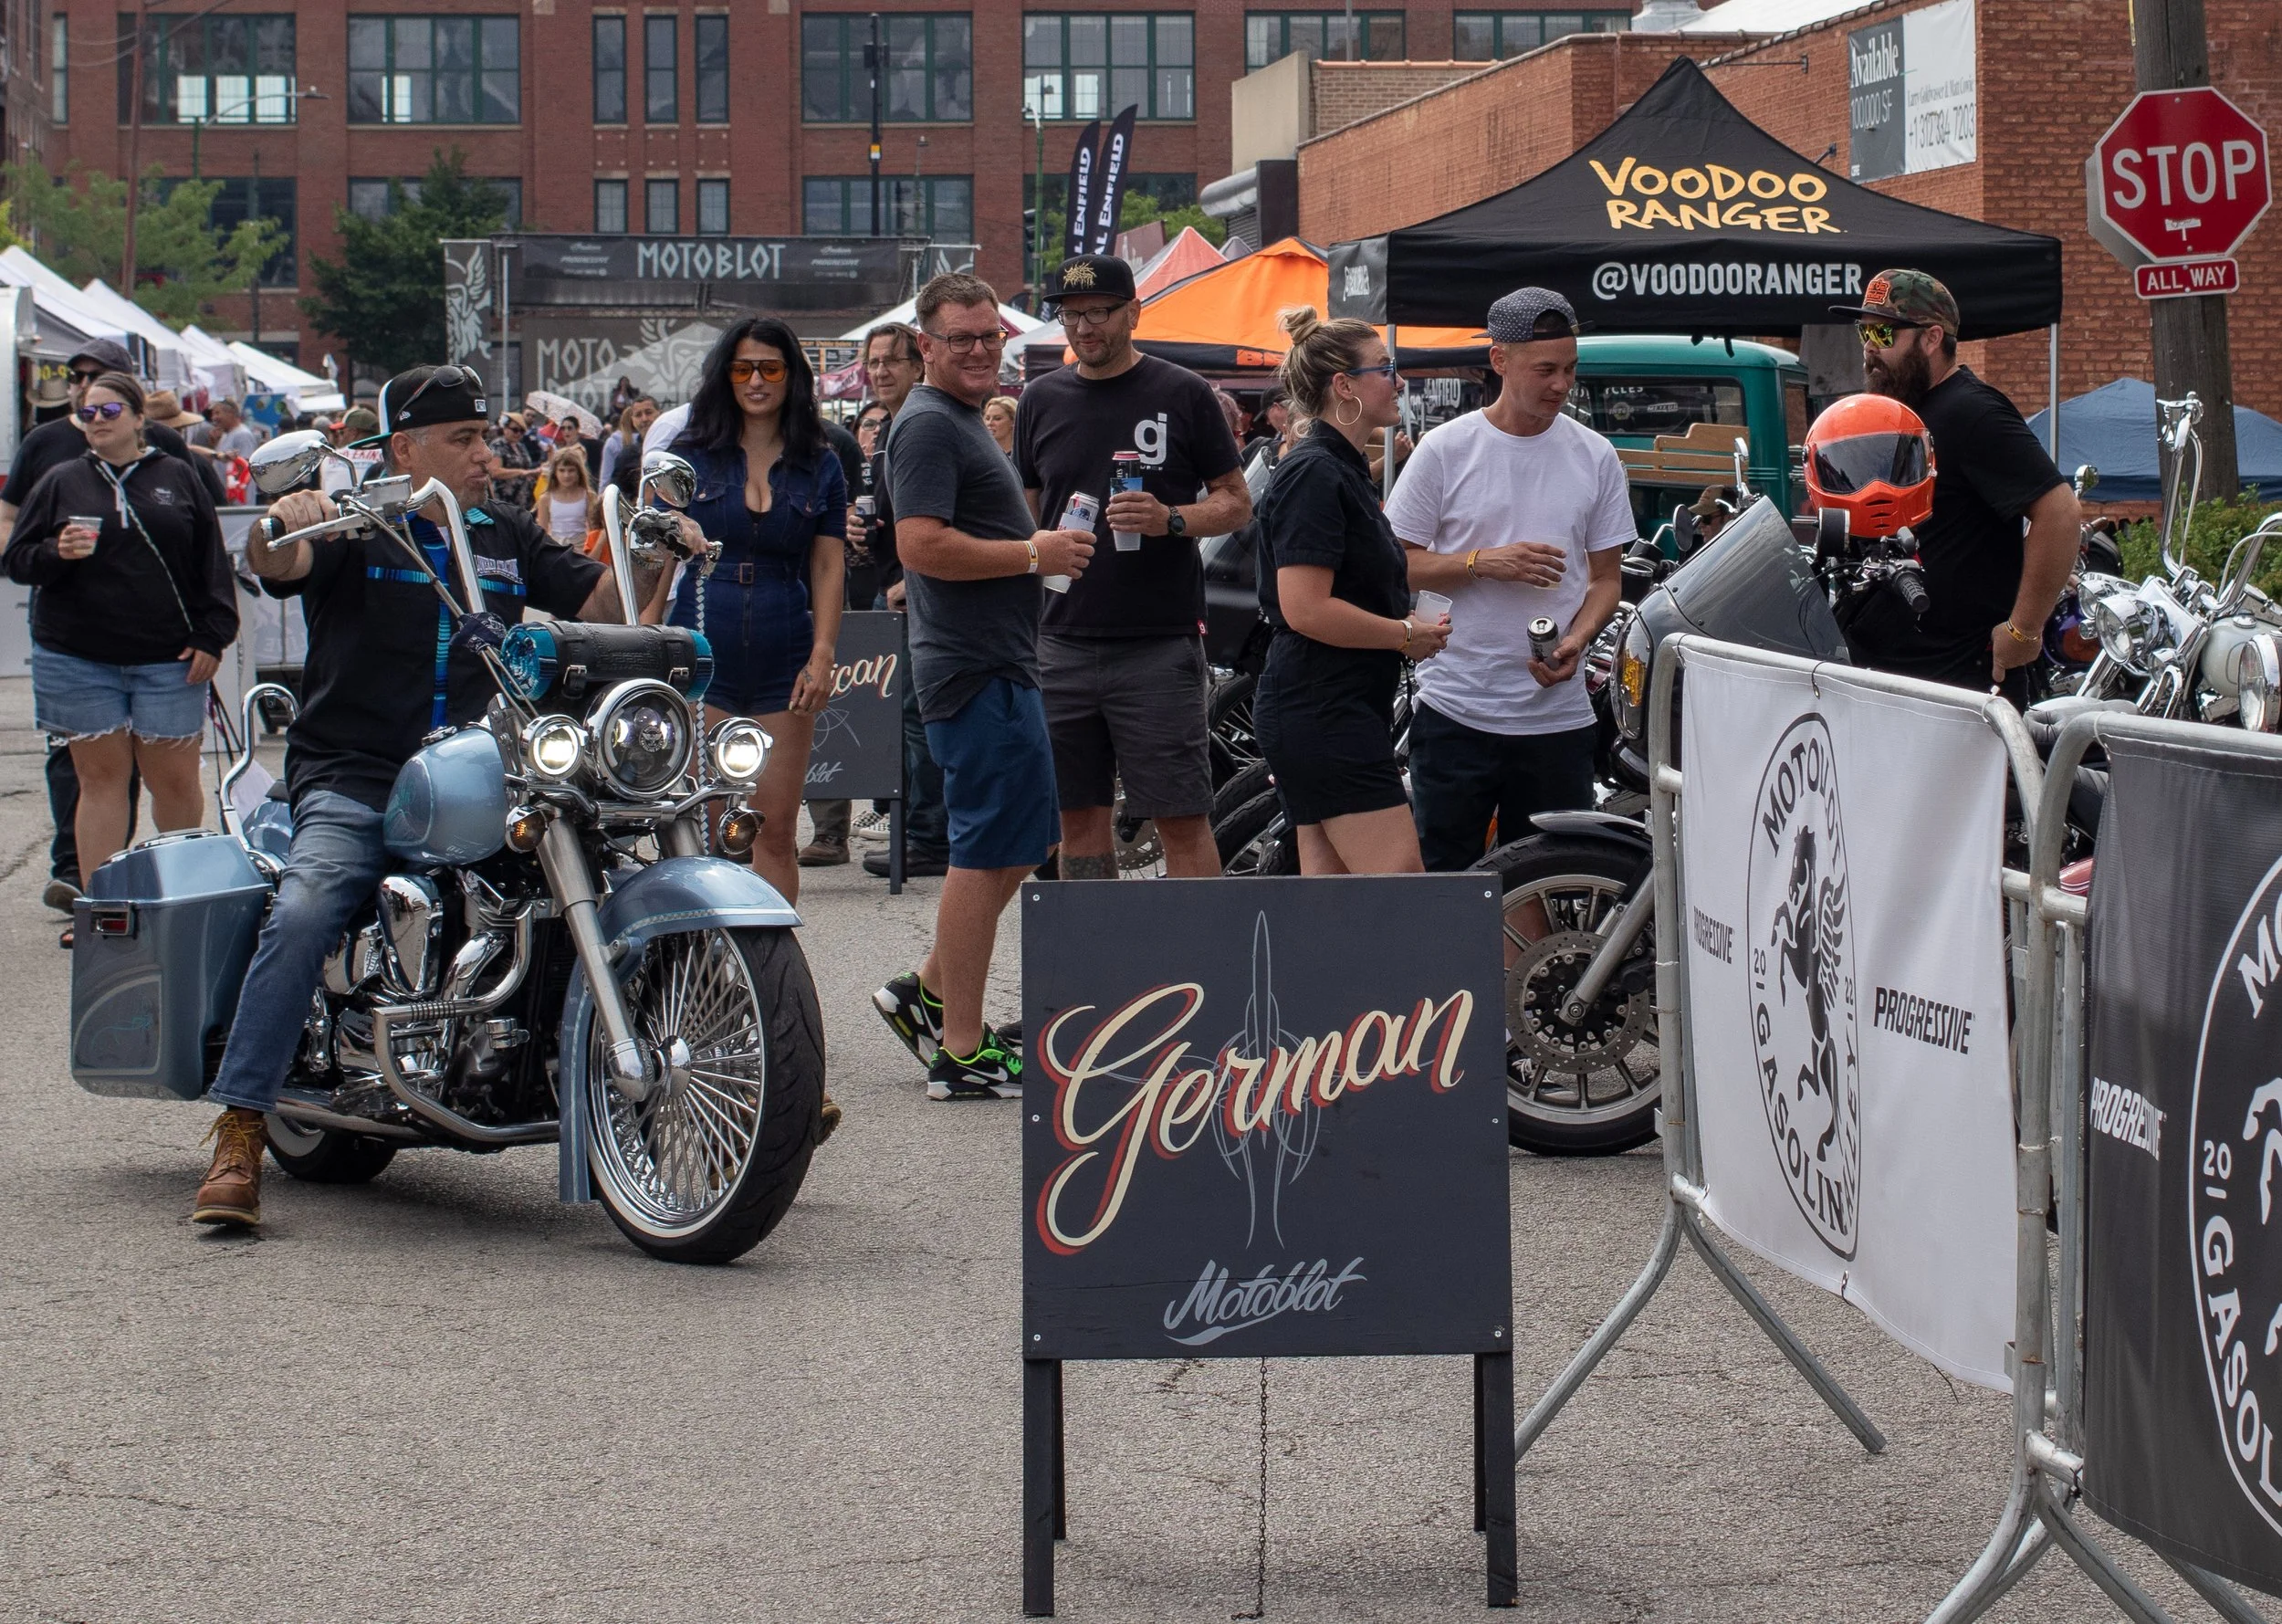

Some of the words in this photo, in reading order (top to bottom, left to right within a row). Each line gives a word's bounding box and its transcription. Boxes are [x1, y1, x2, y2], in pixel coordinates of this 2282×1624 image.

[1849, 32, 1900, 89] Available
[1881, 89, 1893, 123] SF
[1073, 146, 1092, 237] ENFIELD
[1097, 132, 1125, 228] ENFIELD
[1588, 156, 1827, 203] VOODOO
[2112, 141, 2256, 209] STOP
[1607, 198, 1842, 234] RANGER
[637, 241, 786, 279] MOTOBLOT
[1592, 261, 1862, 300] @VOODOORANGER
[2147, 269, 2184, 292] ALL
[2189, 265, 2227, 288] WAY
[537, 338, 617, 391] MOTO
[1693, 905, 1733, 965] PROGRESSIVE
[1753, 948, 1766, 976] 20
[1873, 986, 1973, 1055] PROGRESSIVE
[1037, 981, 1474, 1255] German
[2203, 1139, 2232, 1181] 20
[1164, 1256, 1367, 1346] Motoblot
